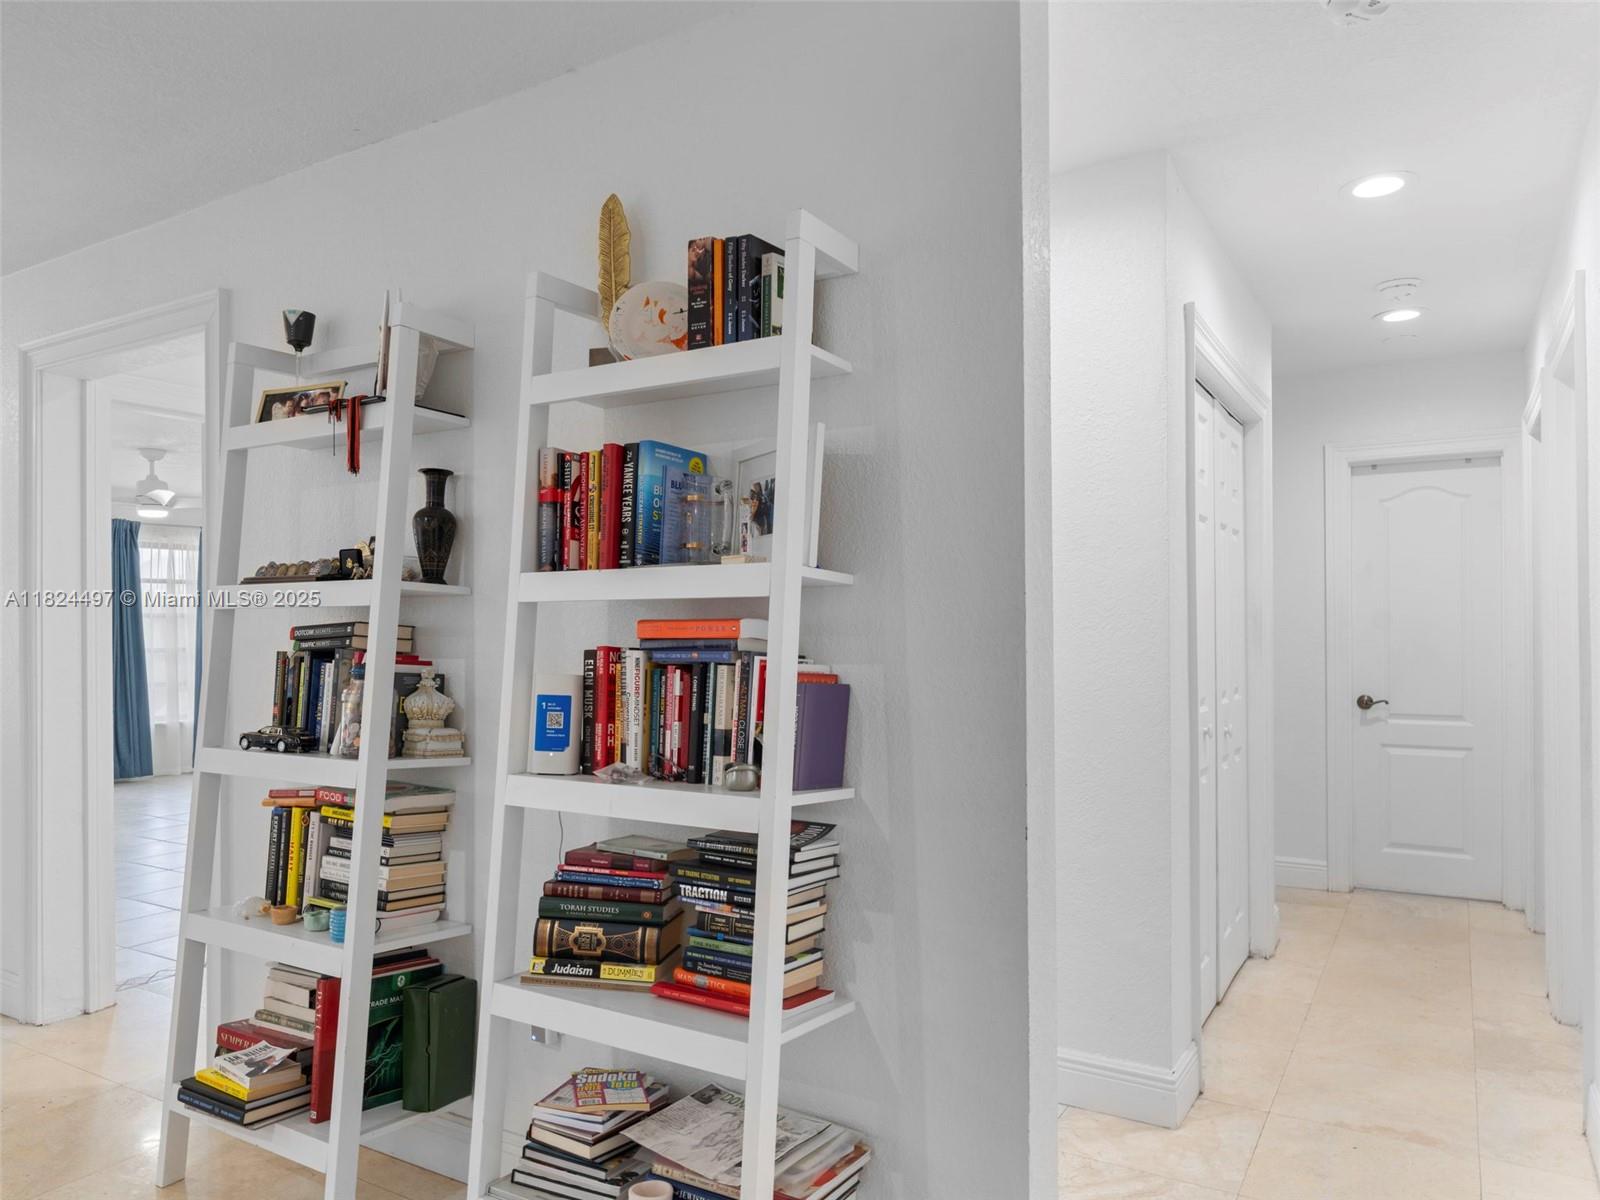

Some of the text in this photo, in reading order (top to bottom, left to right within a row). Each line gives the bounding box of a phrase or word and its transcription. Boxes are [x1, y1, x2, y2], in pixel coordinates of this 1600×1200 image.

[564, 462, 573, 490] SHIFT
[623, 461, 634, 495] YANKEE
[621, 496, 633, 523] YEARS
[583, 659, 595, 719] ELON MUSK
[541, 702, 546, 710] 1
[737, 686, 749, 749] ALTMAN CLOSE
[319, 790, 342, 802] FOOD
[273, 815, 281, 843] EXPERT
[679, 884, 728, 902] TRACTION
[560, 903, 621, 914] TORAH STUDIES
[551, 962, 594, 976] Judaism
[607, 966, 644, 979] DUMMIES
[220, 1031, 251, 1049] SEMPER
[575, 1072, 638, 1084] Sudoku
